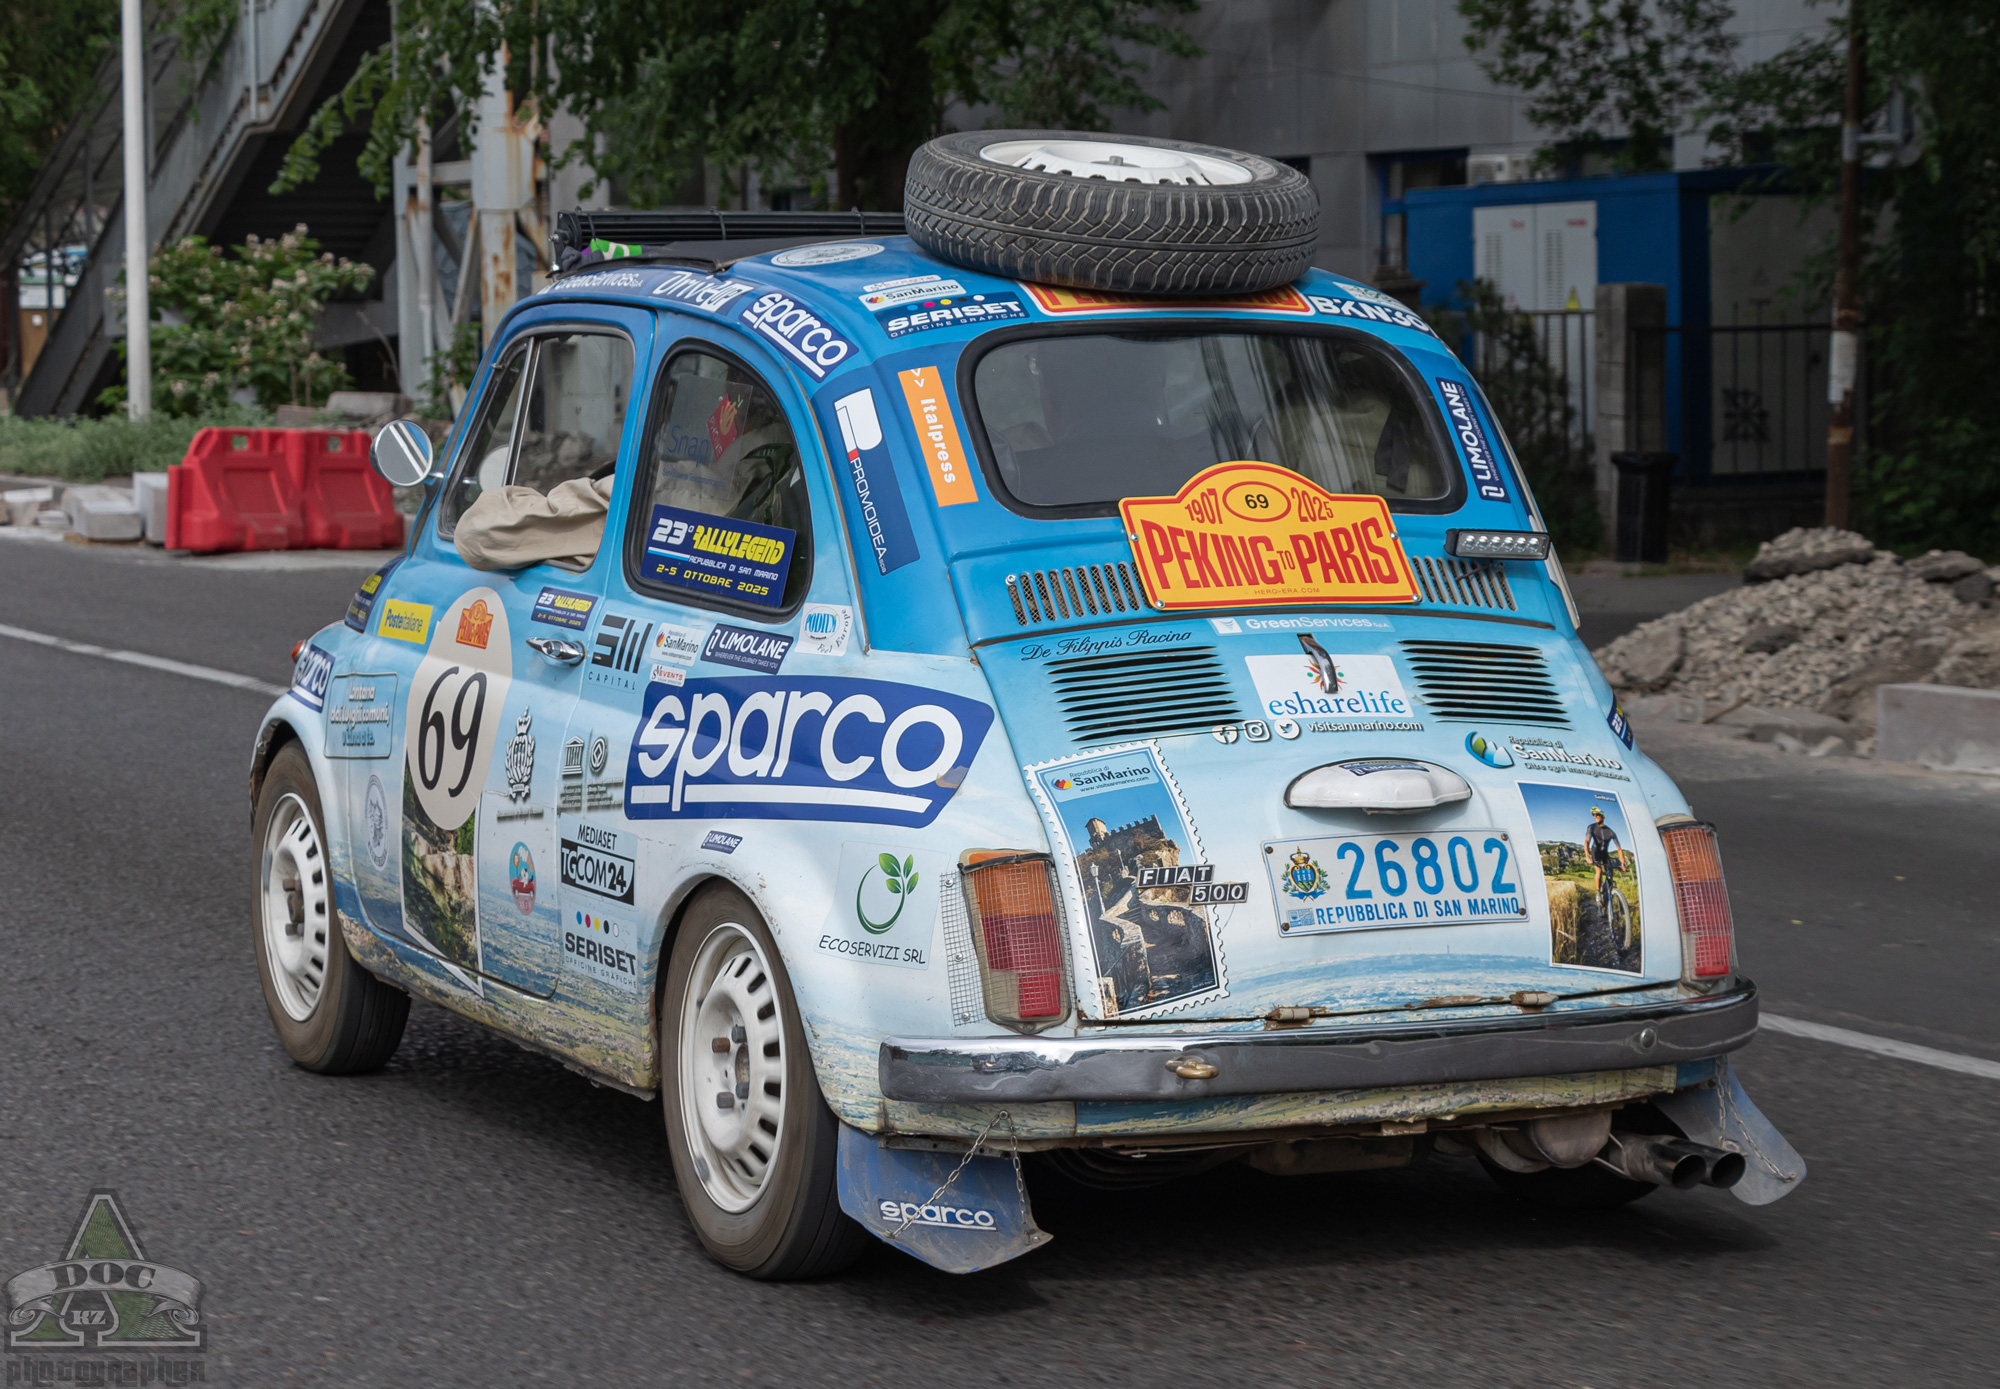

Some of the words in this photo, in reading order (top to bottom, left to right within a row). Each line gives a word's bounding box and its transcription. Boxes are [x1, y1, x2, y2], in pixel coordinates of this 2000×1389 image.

[886, 284, 960, 300] SanMarino
[887, 301, 1020, 332] SERISET
[890, 322, 951, 338] OFFICINE
[959, 312, 1025, 324] GRAFICHE
[752, 292, 849, 368] sparco
[919, 397, 956, 484] Italpress
[1440, 381, 1492, 482] LIMOLANE
[850, 457, 887, 560] PROMOIDEA
[1185, 488, 1224, 525] 1907
[1244, 494, 1270, 509] 69
[1290, 487, 1334, 523] 2025
[692, 525, 786, 565] RALLYLEGEND
[1140, 518, 1284, 590] PEKING
[1276, 549, 1297, 571] TO
[1289, 516, 1400, 584] PARIS
[656, 564, 677, 576] 2-5
[683, 570, 733, 588] OTTOBRE
[737, 581, 770, 596] 2025
[688, 556, 727, 570] REPUBBLICA
[729, 564, 737, 573] DI
[738, 566, 752, 575] SAN
[754, 570, 779, 580] MARINO
[1254, 587, 1321, 595] HERO-ERA.COM
[1245, 617, 1371, 630] GreenServices
[664, 635, 699, 654] SanMarino
[719, 634, 790, 660] LIMOLANE
[1021, 643, 1052, 661] De
[714, 651, 735, 660] WHEREVER
[741, 656, 759, 665] JOURNEY
[588, 671, 636, 691] CAPITAL
[1268, 690, 1406, 716] esharelife
[418, 666, 487, 798] 69
[1306, 718, 1423, 733] visitsanmarino.com
[638, 690, 963, 812] sparco
[1512, 745, 1622, 770] SanMarino
[1069, 768, 1105, 779] Repubblica
[1072, 765, 1151, 786] SanMarino
[1079, 775, 1150, 793] www.visitsanmarino.com
[577, 823, 617, 850] MEDIASET
[708, 832, 740, 848] LIMOLANE
[561, 847, 627, 893] TGCOM24
[1141, 865, 1211, 887] FIAT
[1336, 836, 1516, 900] 26802
[1193, 882, 1245, 902] 500
[1315, 902, 1408, 925] REPUBBLICA
[1413, 900, 1430, 917] DI
[1435, 898, 1463, 916] SAN
[1468, 897, 1519, 915] MARINO
[565, 932, 636, 975] SERISET
[819, 935, 900, 961] ECOSERVIZI
[904, 950, 926, 964] SRL
[565, 955, 597, 974] OFFICINE
[601, 969, 637, 988] GRAFICHE
[880, 1201, 996, 1231] sparco
